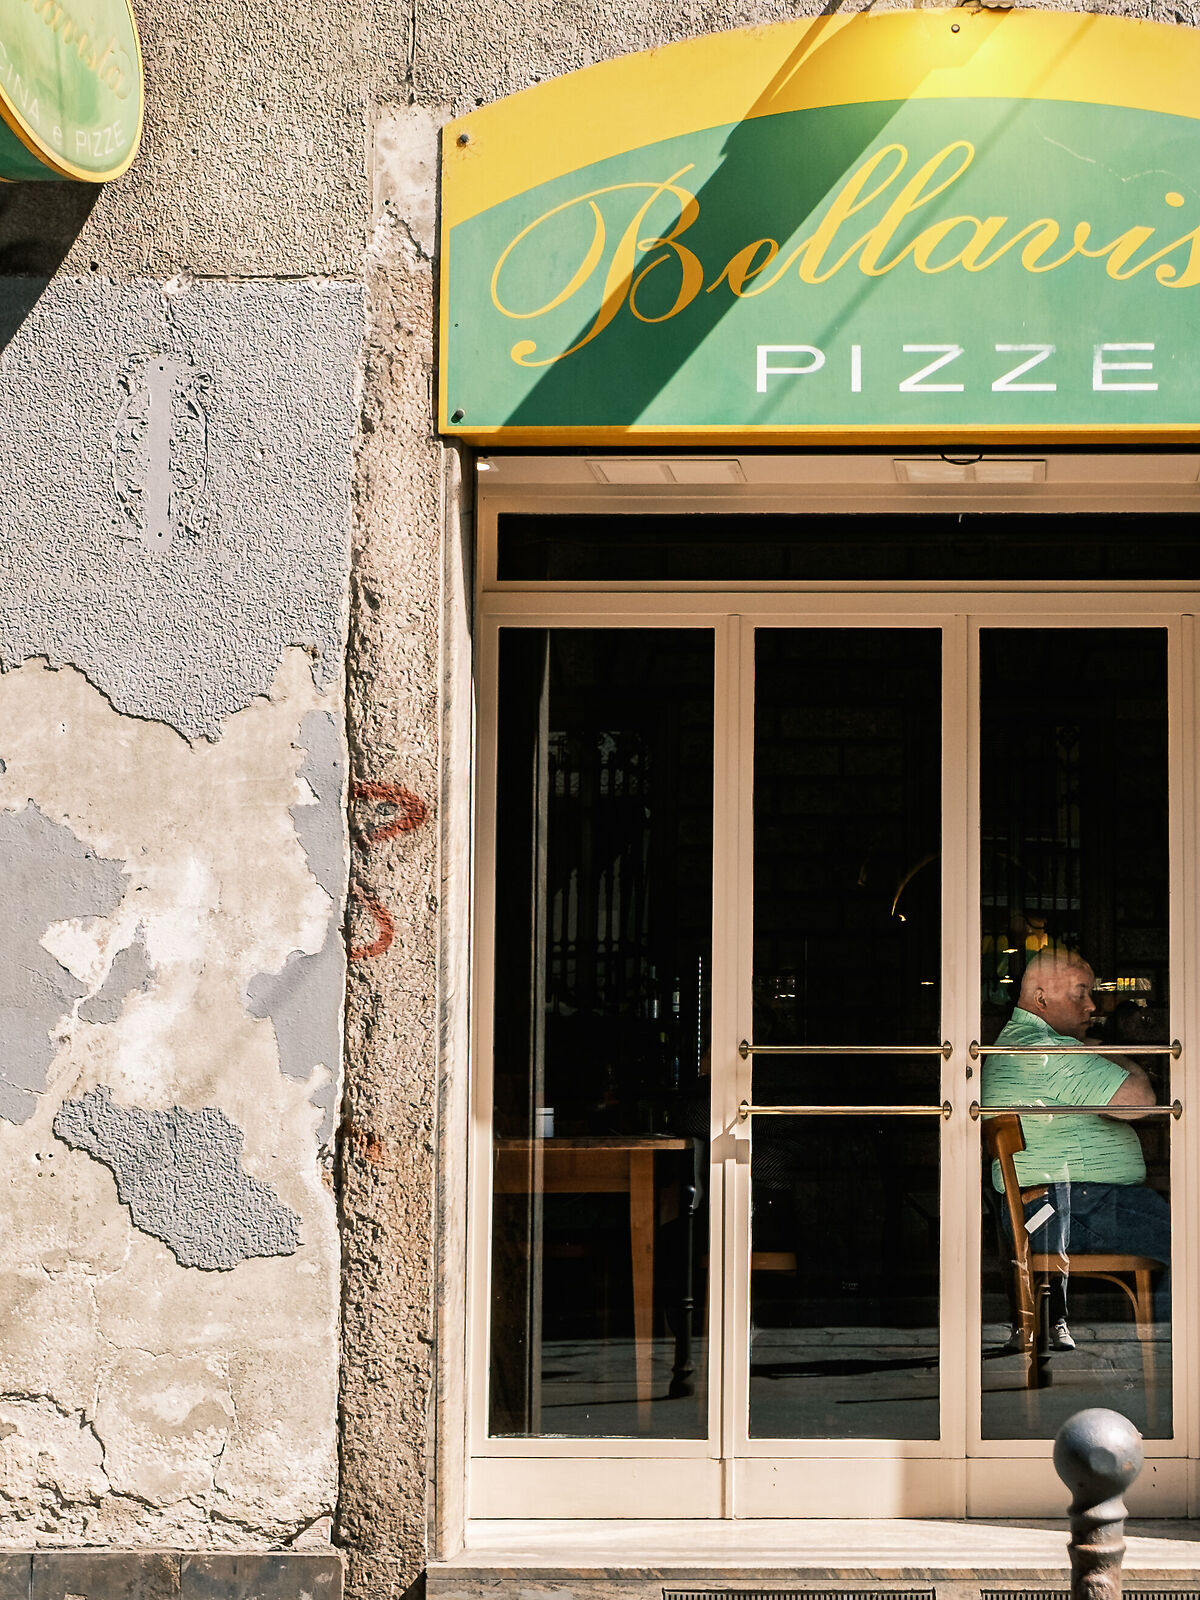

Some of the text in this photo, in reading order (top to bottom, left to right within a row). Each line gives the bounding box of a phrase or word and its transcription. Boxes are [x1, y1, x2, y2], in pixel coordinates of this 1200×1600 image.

[52, 125, 63, 146] e
[75, 120, 126, 157] PIZZE
[757, 343, 1159, 394] PIZZE
